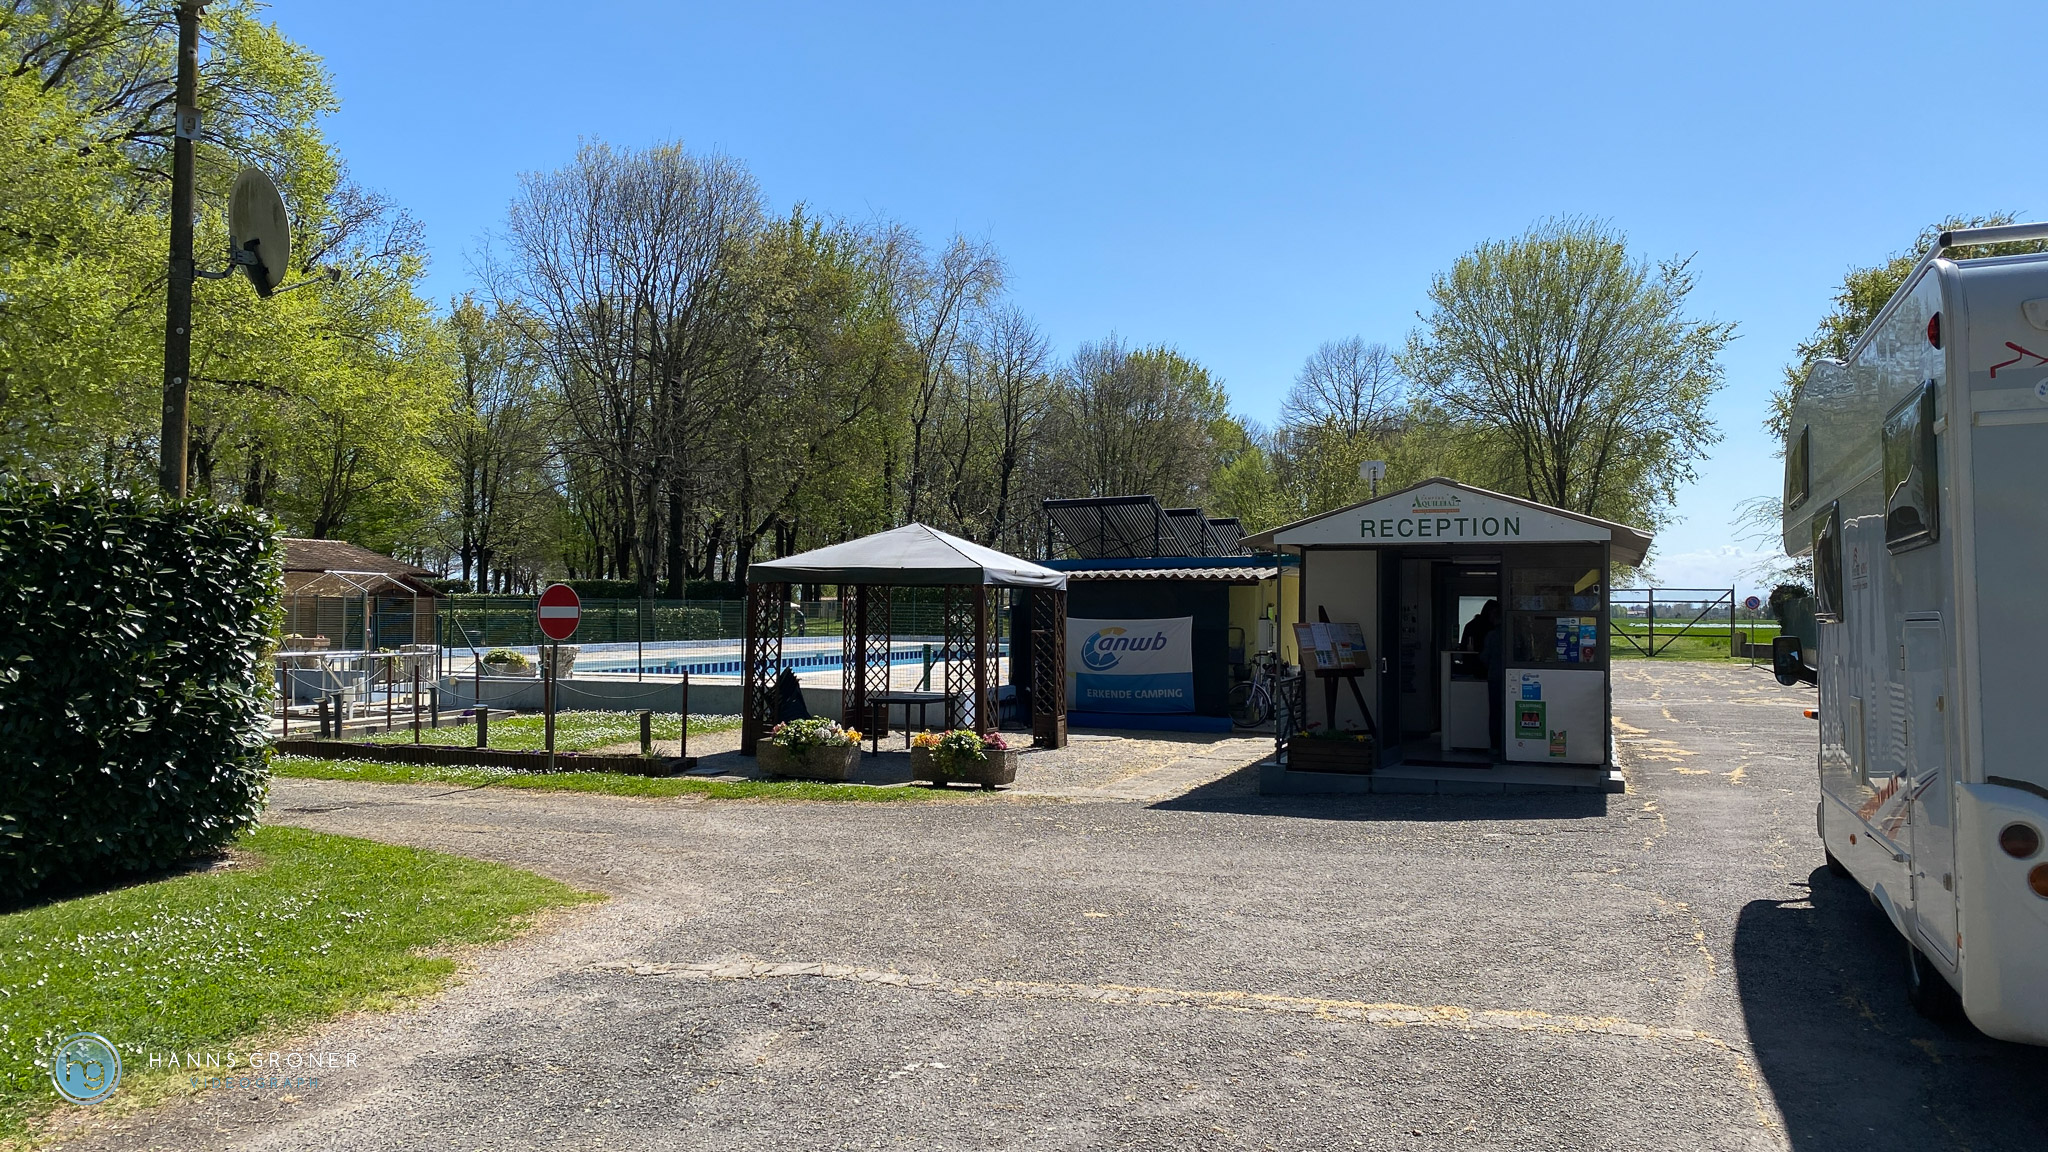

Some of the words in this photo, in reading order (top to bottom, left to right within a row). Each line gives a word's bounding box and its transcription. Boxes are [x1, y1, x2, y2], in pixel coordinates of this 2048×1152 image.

[1361, 517, 1520, 538] RECEPTION
[1098, 631, 1167, 651] anwb
[1087, 688, 1132, 699] ERKENDE
[1134, 688, 1183, 699] CAMPING
